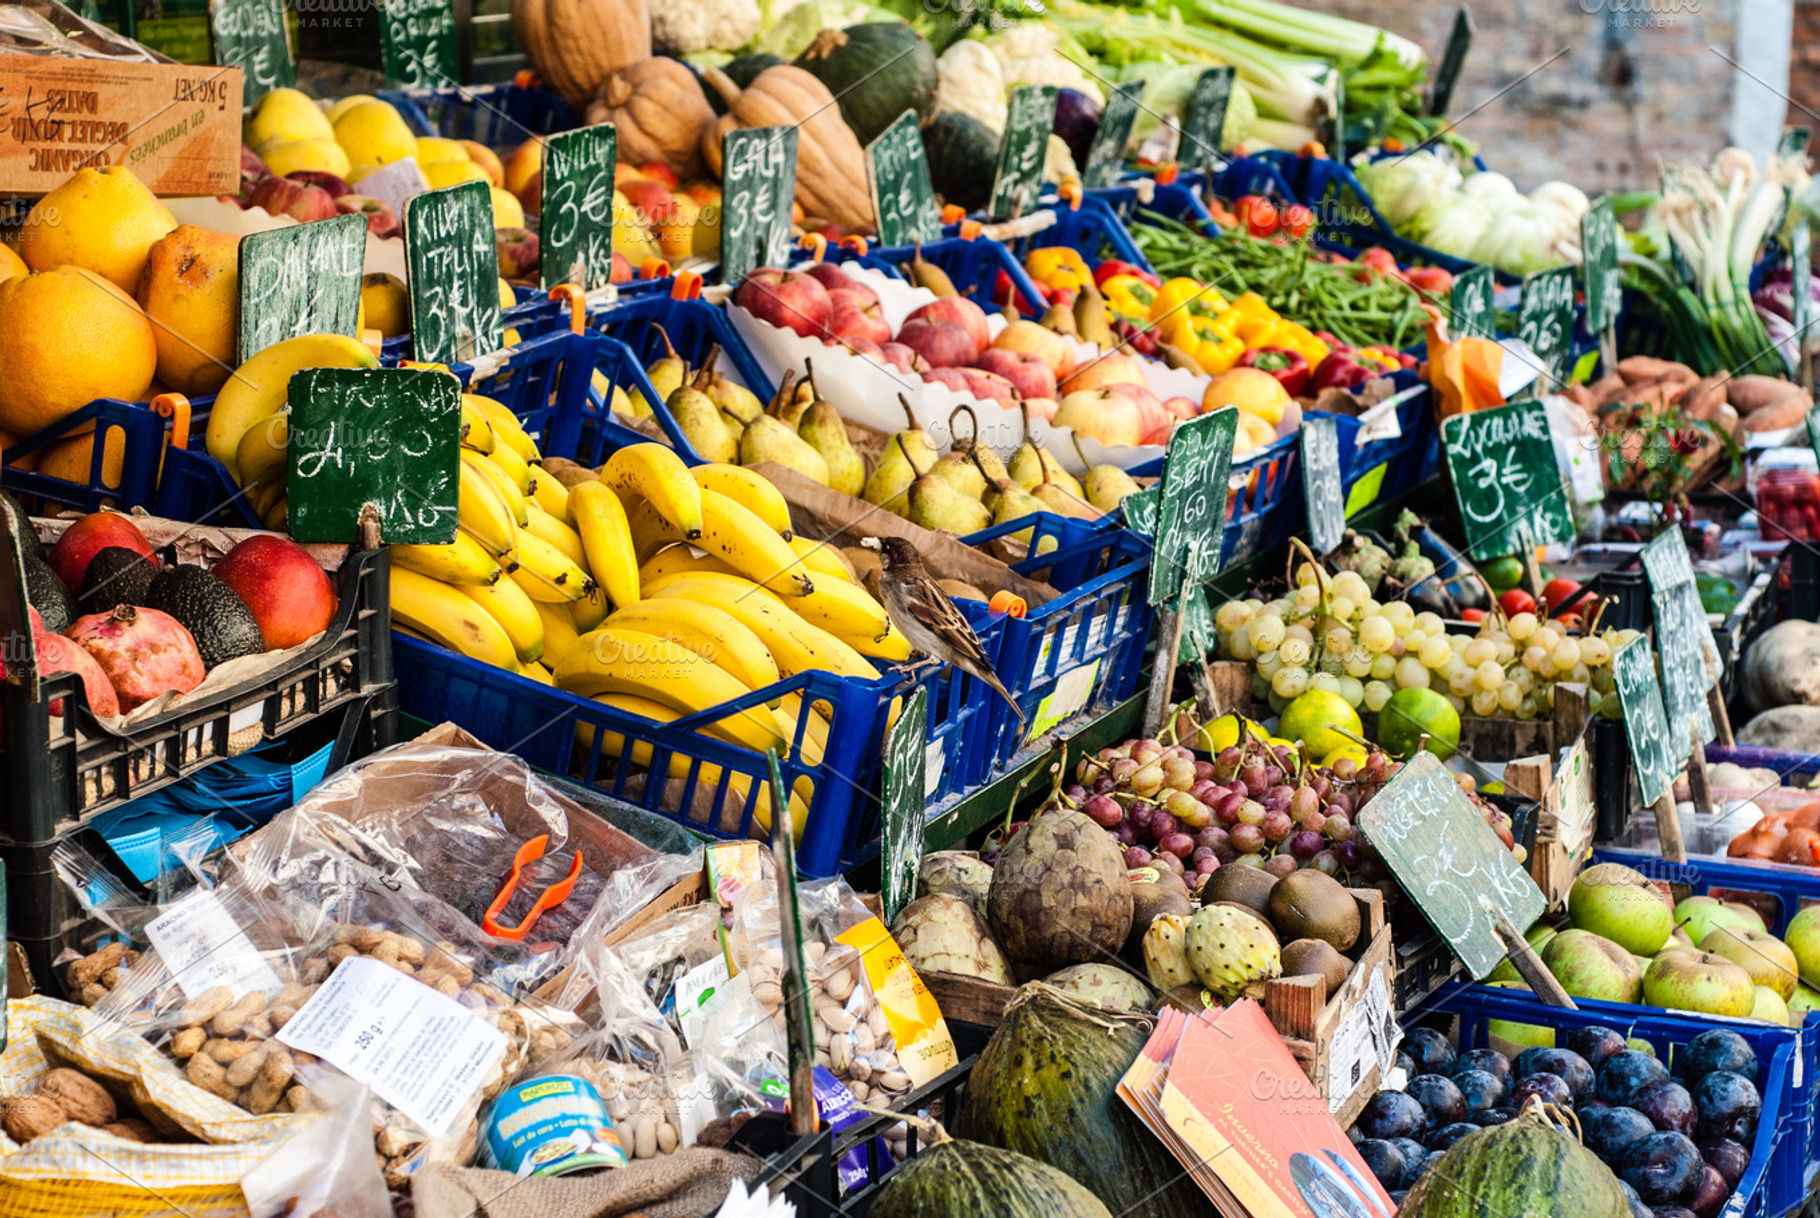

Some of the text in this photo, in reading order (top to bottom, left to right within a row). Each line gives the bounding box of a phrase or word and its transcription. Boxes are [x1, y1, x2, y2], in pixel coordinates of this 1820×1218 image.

[217, 80, 228, 112] 5
[67, 120, 130, 146] DEGLET
[728, 129, 787, 181] GALA
[1465, 445, 1535, 524] 3€
[353, 1024, 383, 1050] 250 g
[1219, 1103, 1280, 1171] Inverno
